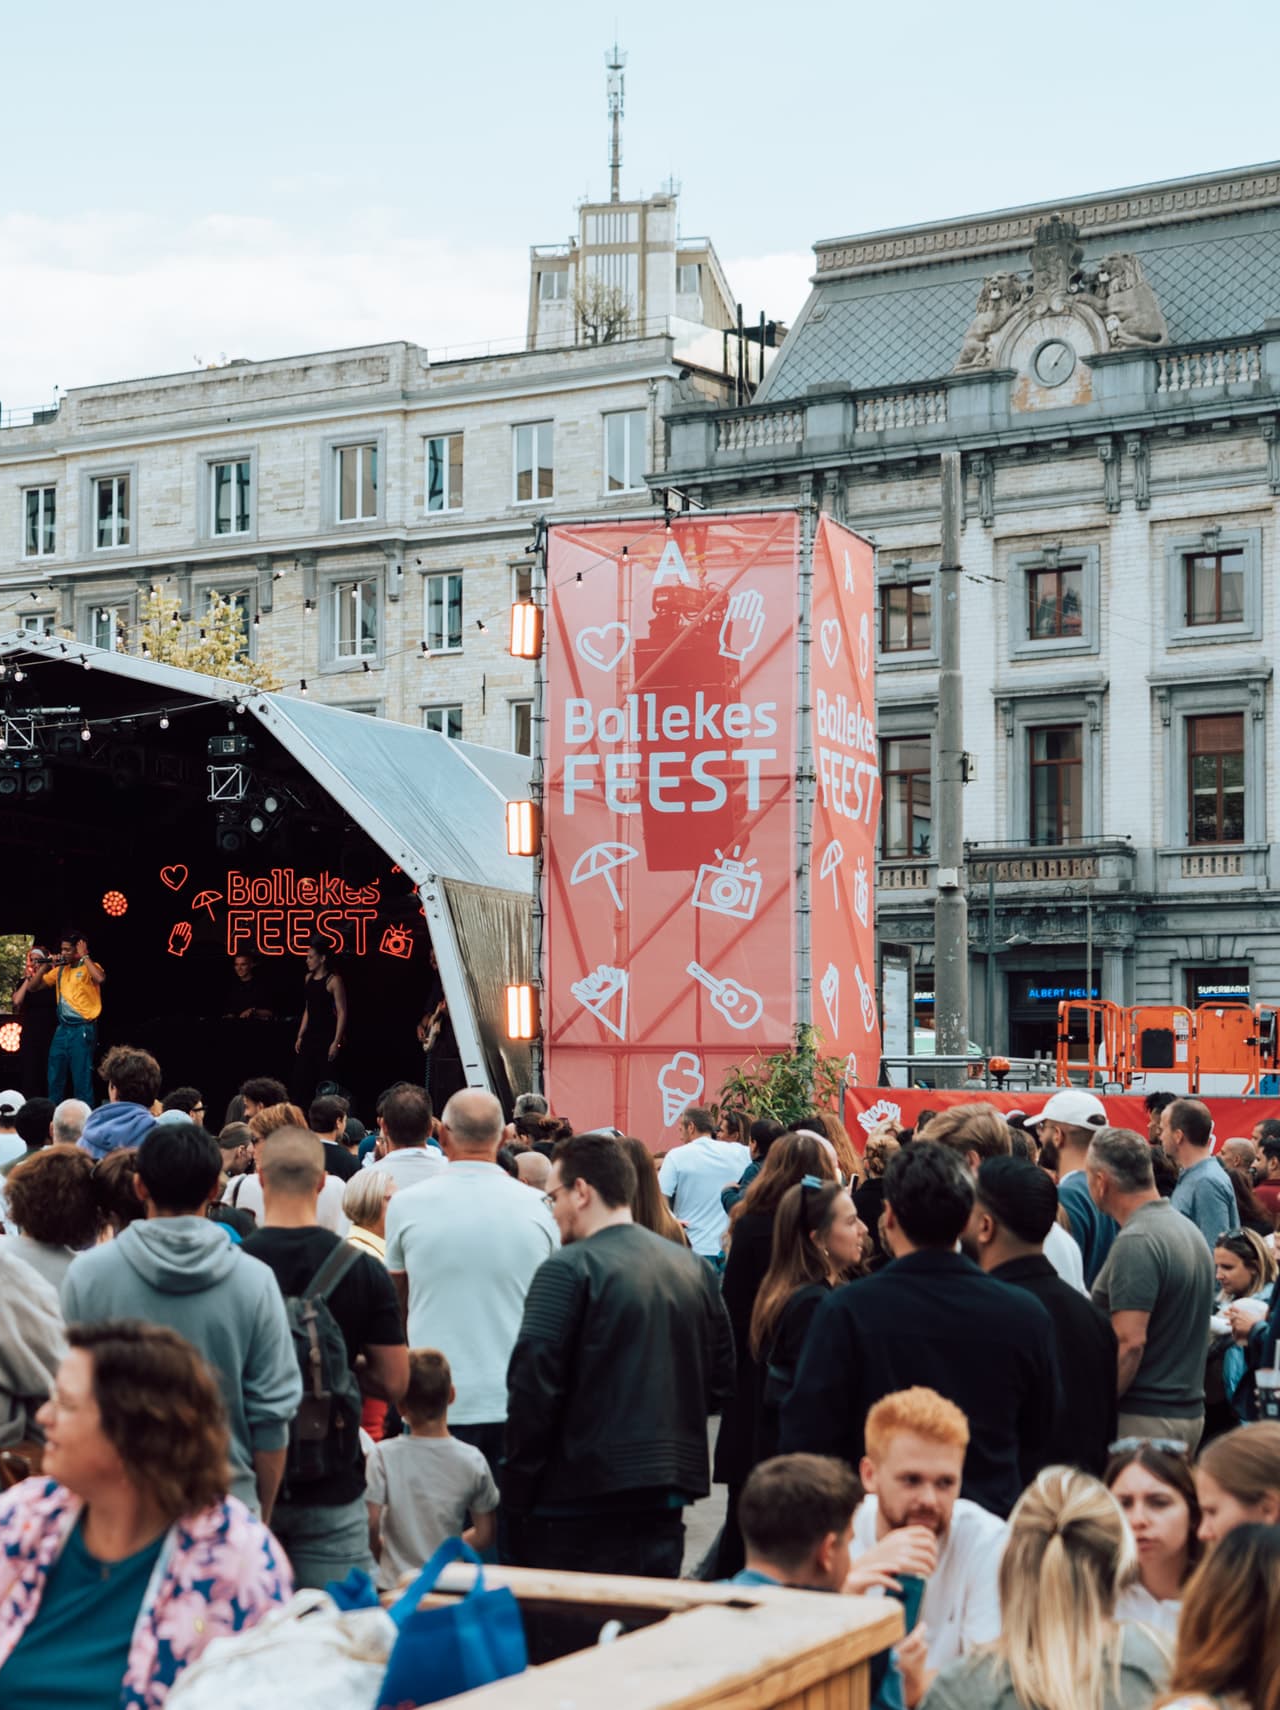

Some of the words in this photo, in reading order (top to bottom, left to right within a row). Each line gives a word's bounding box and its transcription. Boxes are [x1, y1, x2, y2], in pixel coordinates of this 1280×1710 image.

[652, 540, 691, 585] A
[565, 691, 777, 744] Bollekes
[564, 749, 776, 815] FEEST
[819, 746, 879, 825] FEEST
[227, 909, 378, 956] FEEST
[1028, 987, 1065, 999] ALBERT
